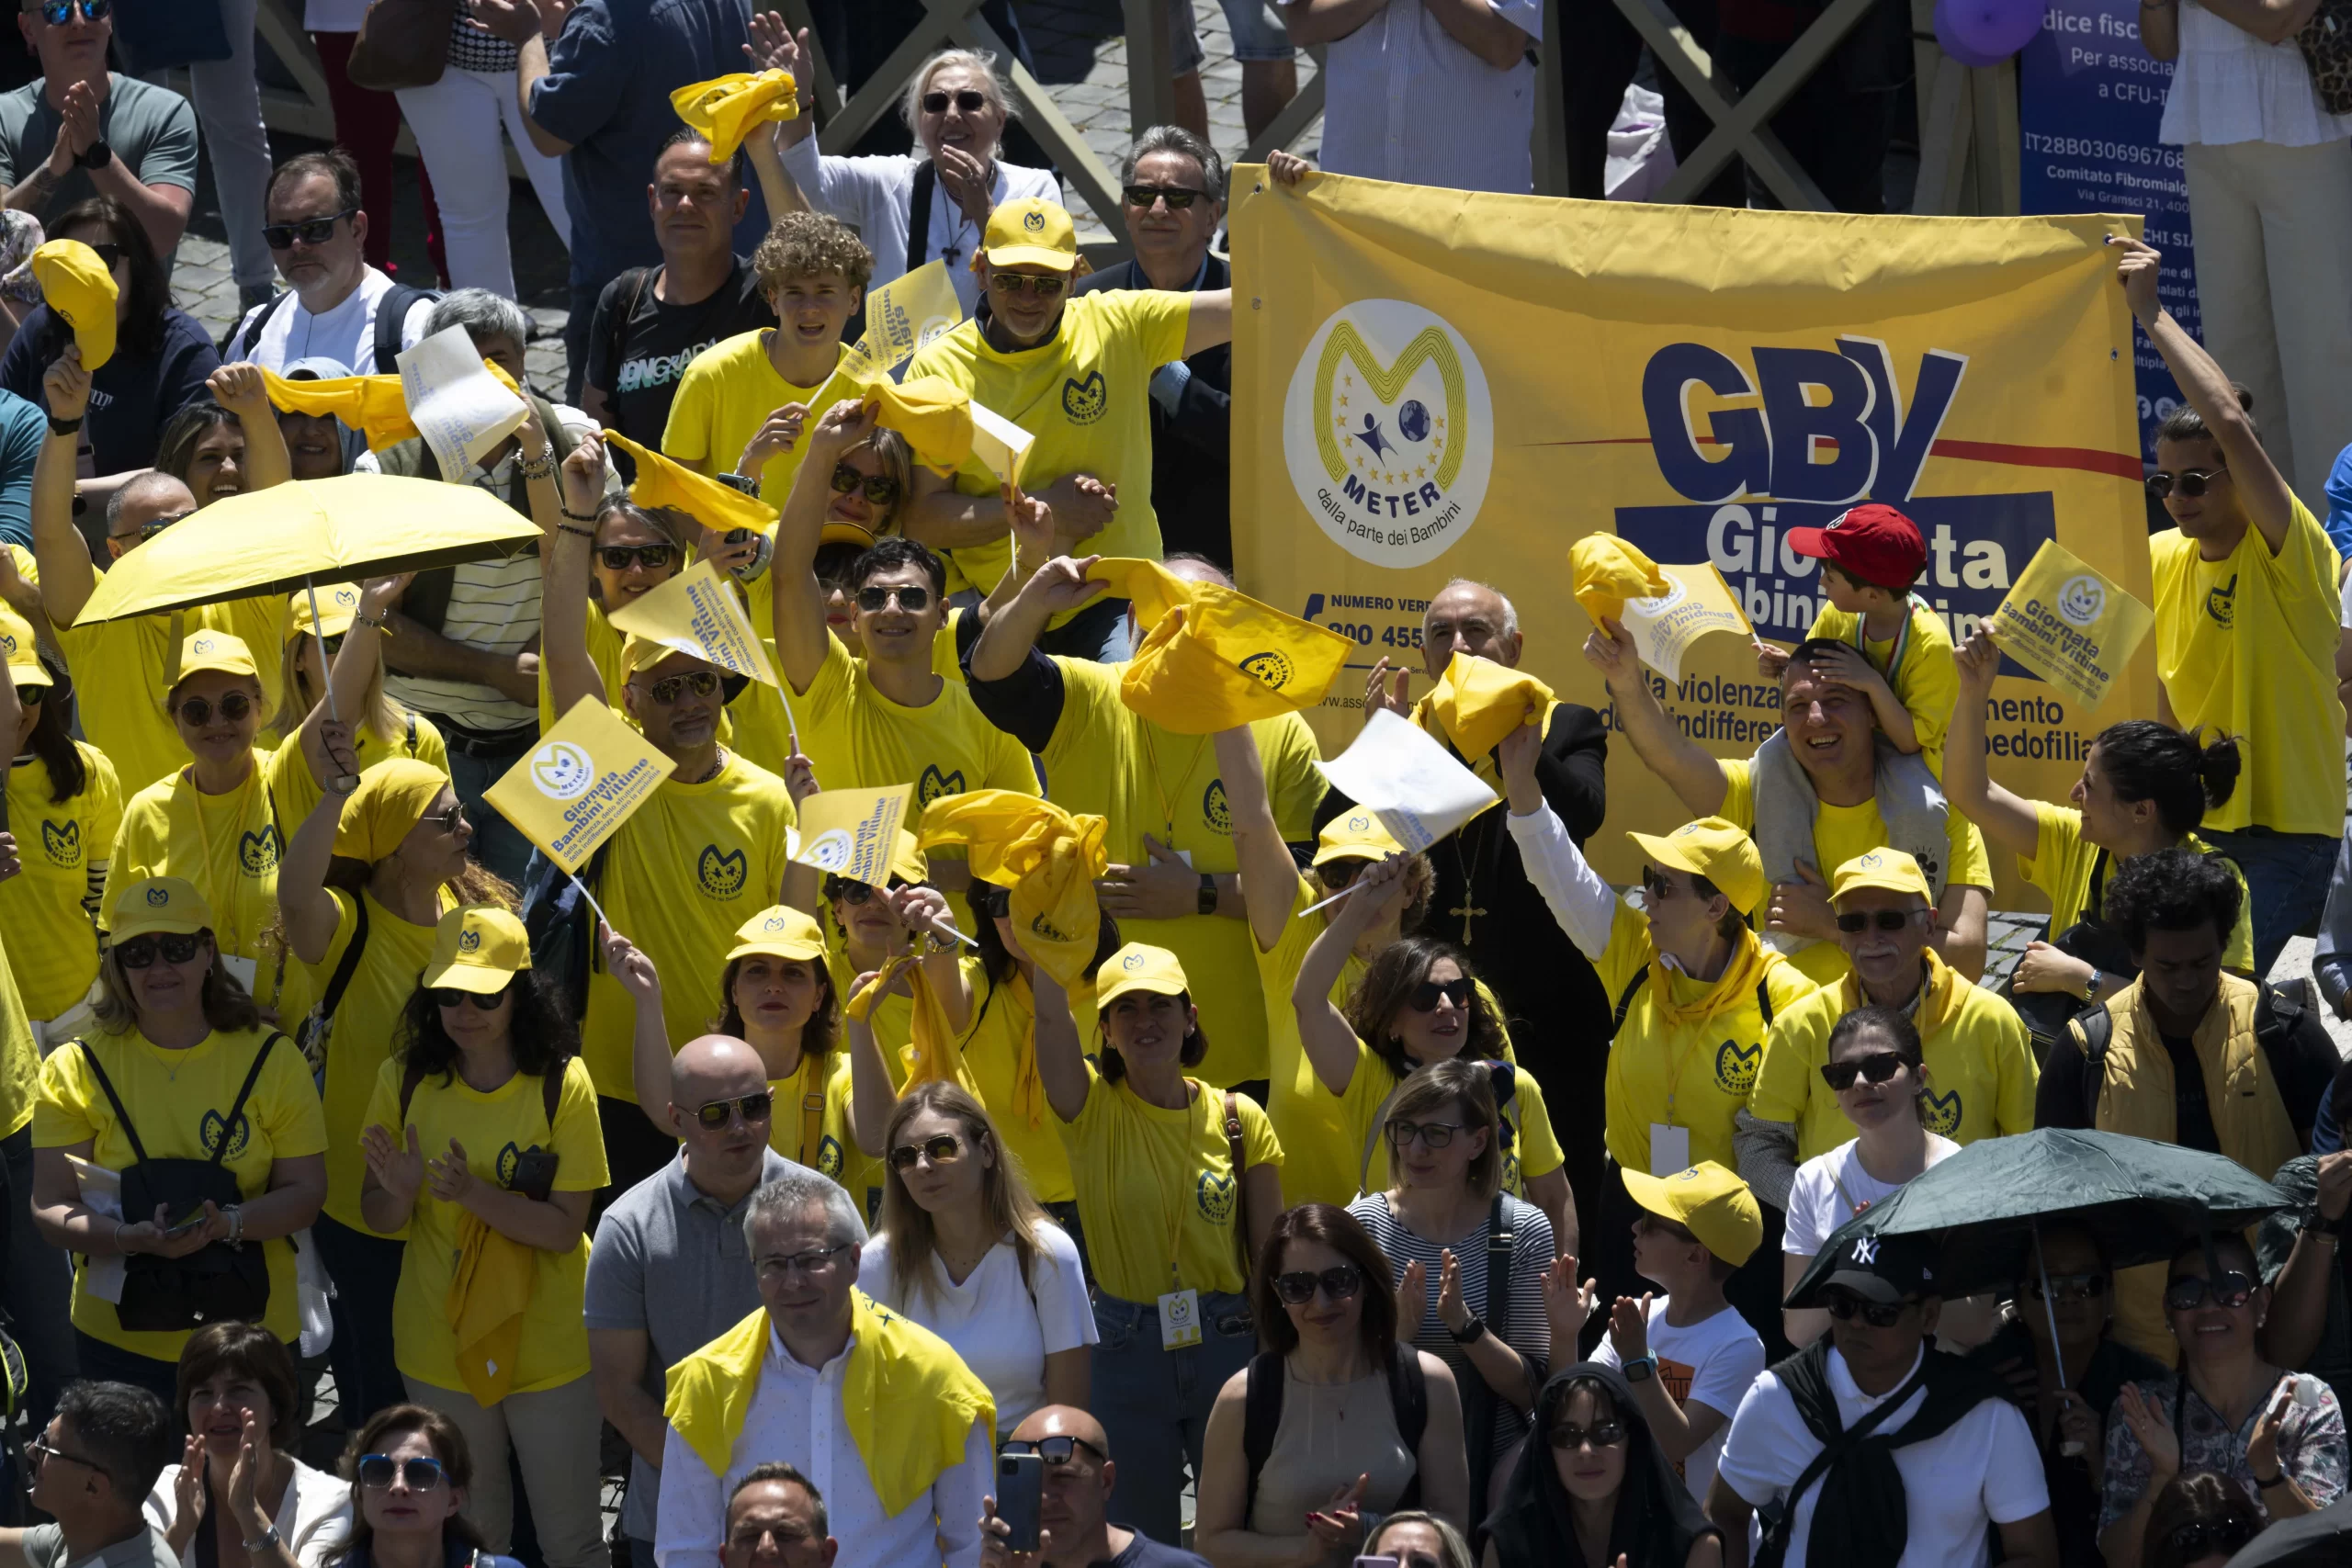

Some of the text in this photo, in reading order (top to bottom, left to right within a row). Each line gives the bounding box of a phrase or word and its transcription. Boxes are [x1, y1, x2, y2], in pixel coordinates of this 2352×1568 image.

[2098, 13, 2142, 39] fisc
[2071, 47, 2176, 76] Per associa
[2098, 84, 2109, 97] a
[2025, 132, 2184, 170] IT28B030696768
[2047, 165, 2188, 197] Comitato Fibromialg
[2077, 188, 2095, 201] Via
[2098, 191, 2143, 208] Gramsci
[2146, 197, 2164, 211] 21,
[2143, 228, 2168, 244] CHI
[2181, 267, 2191, 279] di
[1073, 405, 1102, 419] METER
[1643, 333, 1969, 505] GBV
[1343, 474, 1441, 518] METER
[1317, 488, 1462, 546] dalla parte dei Bambini
[1706, 504, 2011, 590] Giota
[686, 584, 720, 641] Vittime
[1331, 594, 1394, 610] NUMERO
[1731, 577, 1829, 630] bini
[691, 617, 722, 667] ornata
[1381, 626, 1423, 649] 455
[2002, 601, 2059, 645] Bambini
[2061, 640, 2109, 682] Vittime
[2025, 599, 2099, 659] Giornata
[1272, 653, 1288, 681] METER
[1678, 672, 1781, 709] violenza
[561, 768, 584, 790] METER
[551, 800, 604, 852] Bambini
[601, 759, 649, 802] Vittime
[563, 772, 618, 822] Giornata
[563, 843, 578, 858] della
[577, 820, 604, 843] violenza,
[601, 805, 616, 819] dello
[616, 770, 650, 806] sfruttamento
[569, 848, 583, 863] della
[582, 818, 615, 849] indifferenza
[613, 799, 632, 818] contro
[638, 770, 662, 795] pedofilia
[866, 796, 887, 841] Vittime
[51, 852, 79, 863] METER
[850, 819, 869, 875] Giornata
[247, 861, 277, 873] METER
[704, 882, 739, 895] METER
[1721, 1076, 1754, 1090] METER
[208, 1145, 242, 1156] MER
[1850, 1236, 1881, 1265] NY
